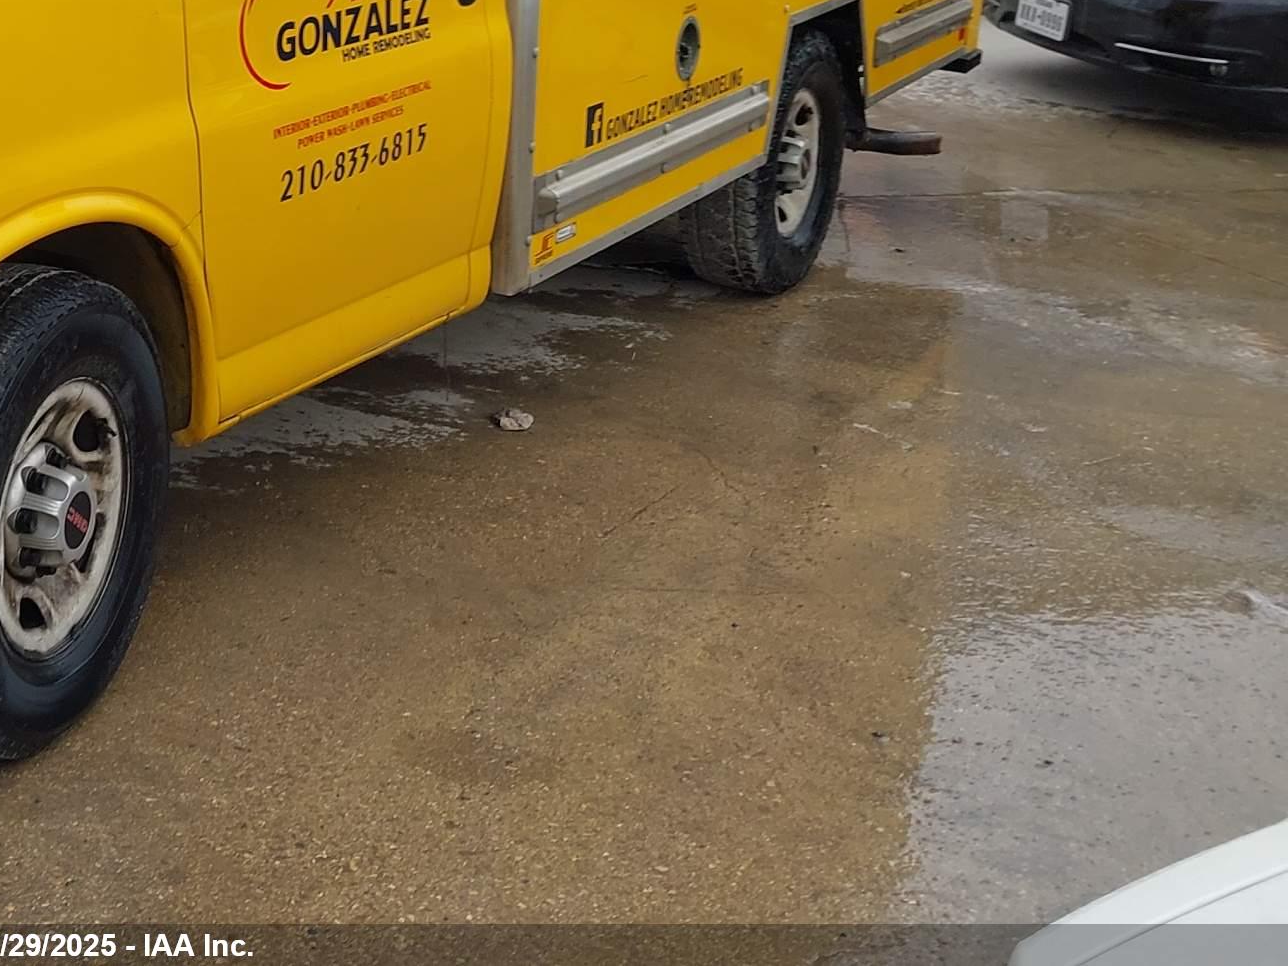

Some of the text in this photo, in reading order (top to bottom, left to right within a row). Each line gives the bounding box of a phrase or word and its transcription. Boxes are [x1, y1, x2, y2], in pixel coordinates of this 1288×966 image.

[341, 27, 432, 62] HOME REMODELING
[279, 122, 428, 203] 210-833-6815
